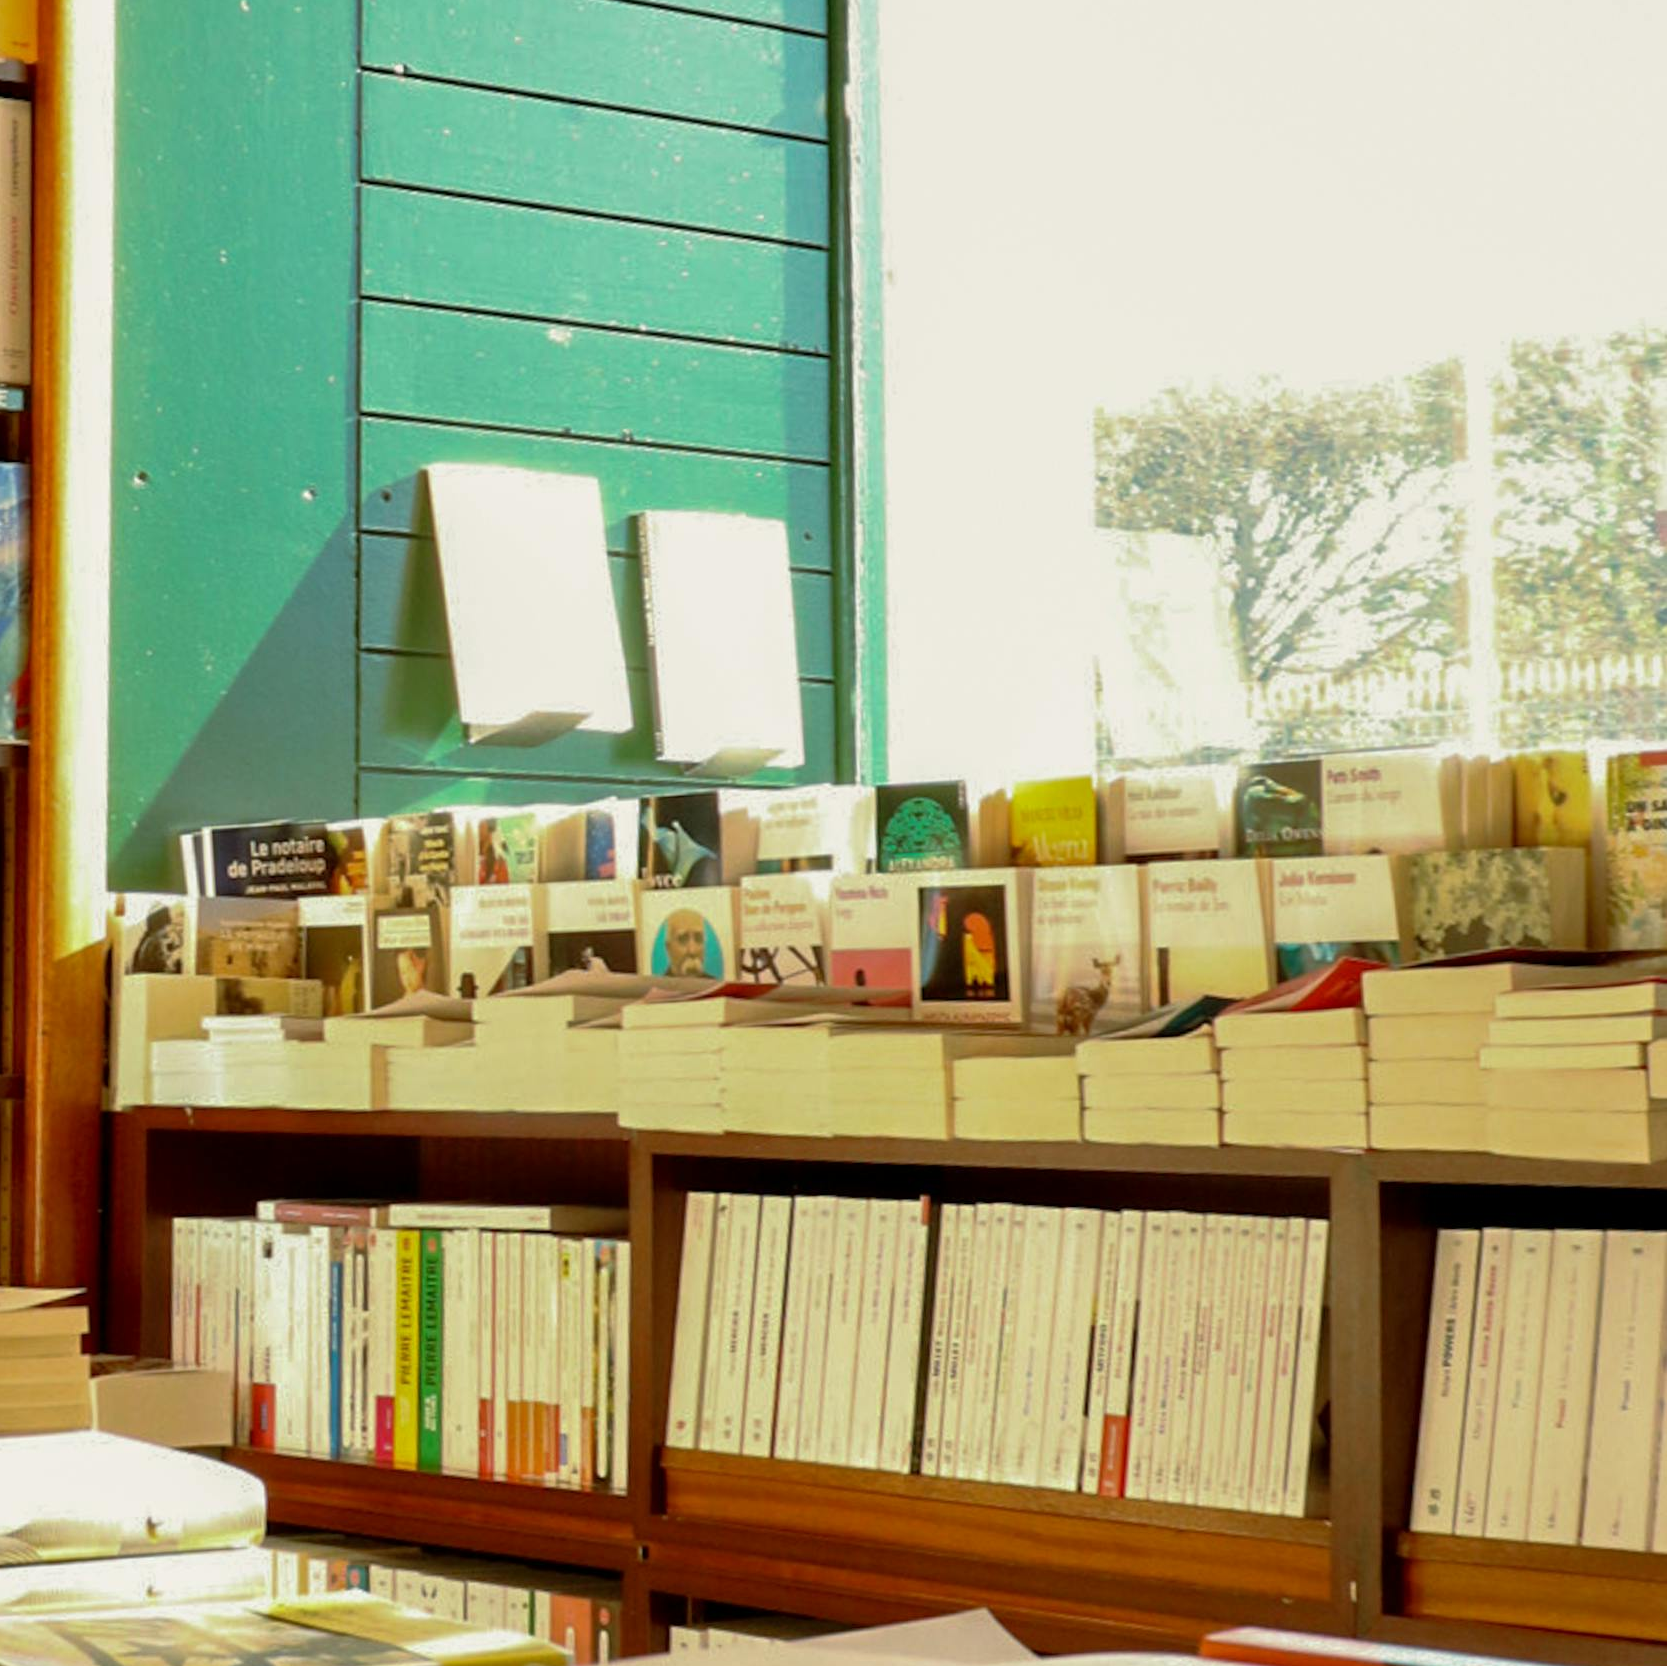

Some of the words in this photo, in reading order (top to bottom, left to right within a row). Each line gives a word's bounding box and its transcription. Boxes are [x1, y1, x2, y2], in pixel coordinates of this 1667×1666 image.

[250, 840, 268, 857] Le
[272, 837, 326, 853] notaire
[227, 861, 248, 878] de
[250, 857, 326, 877] Pradeloup
